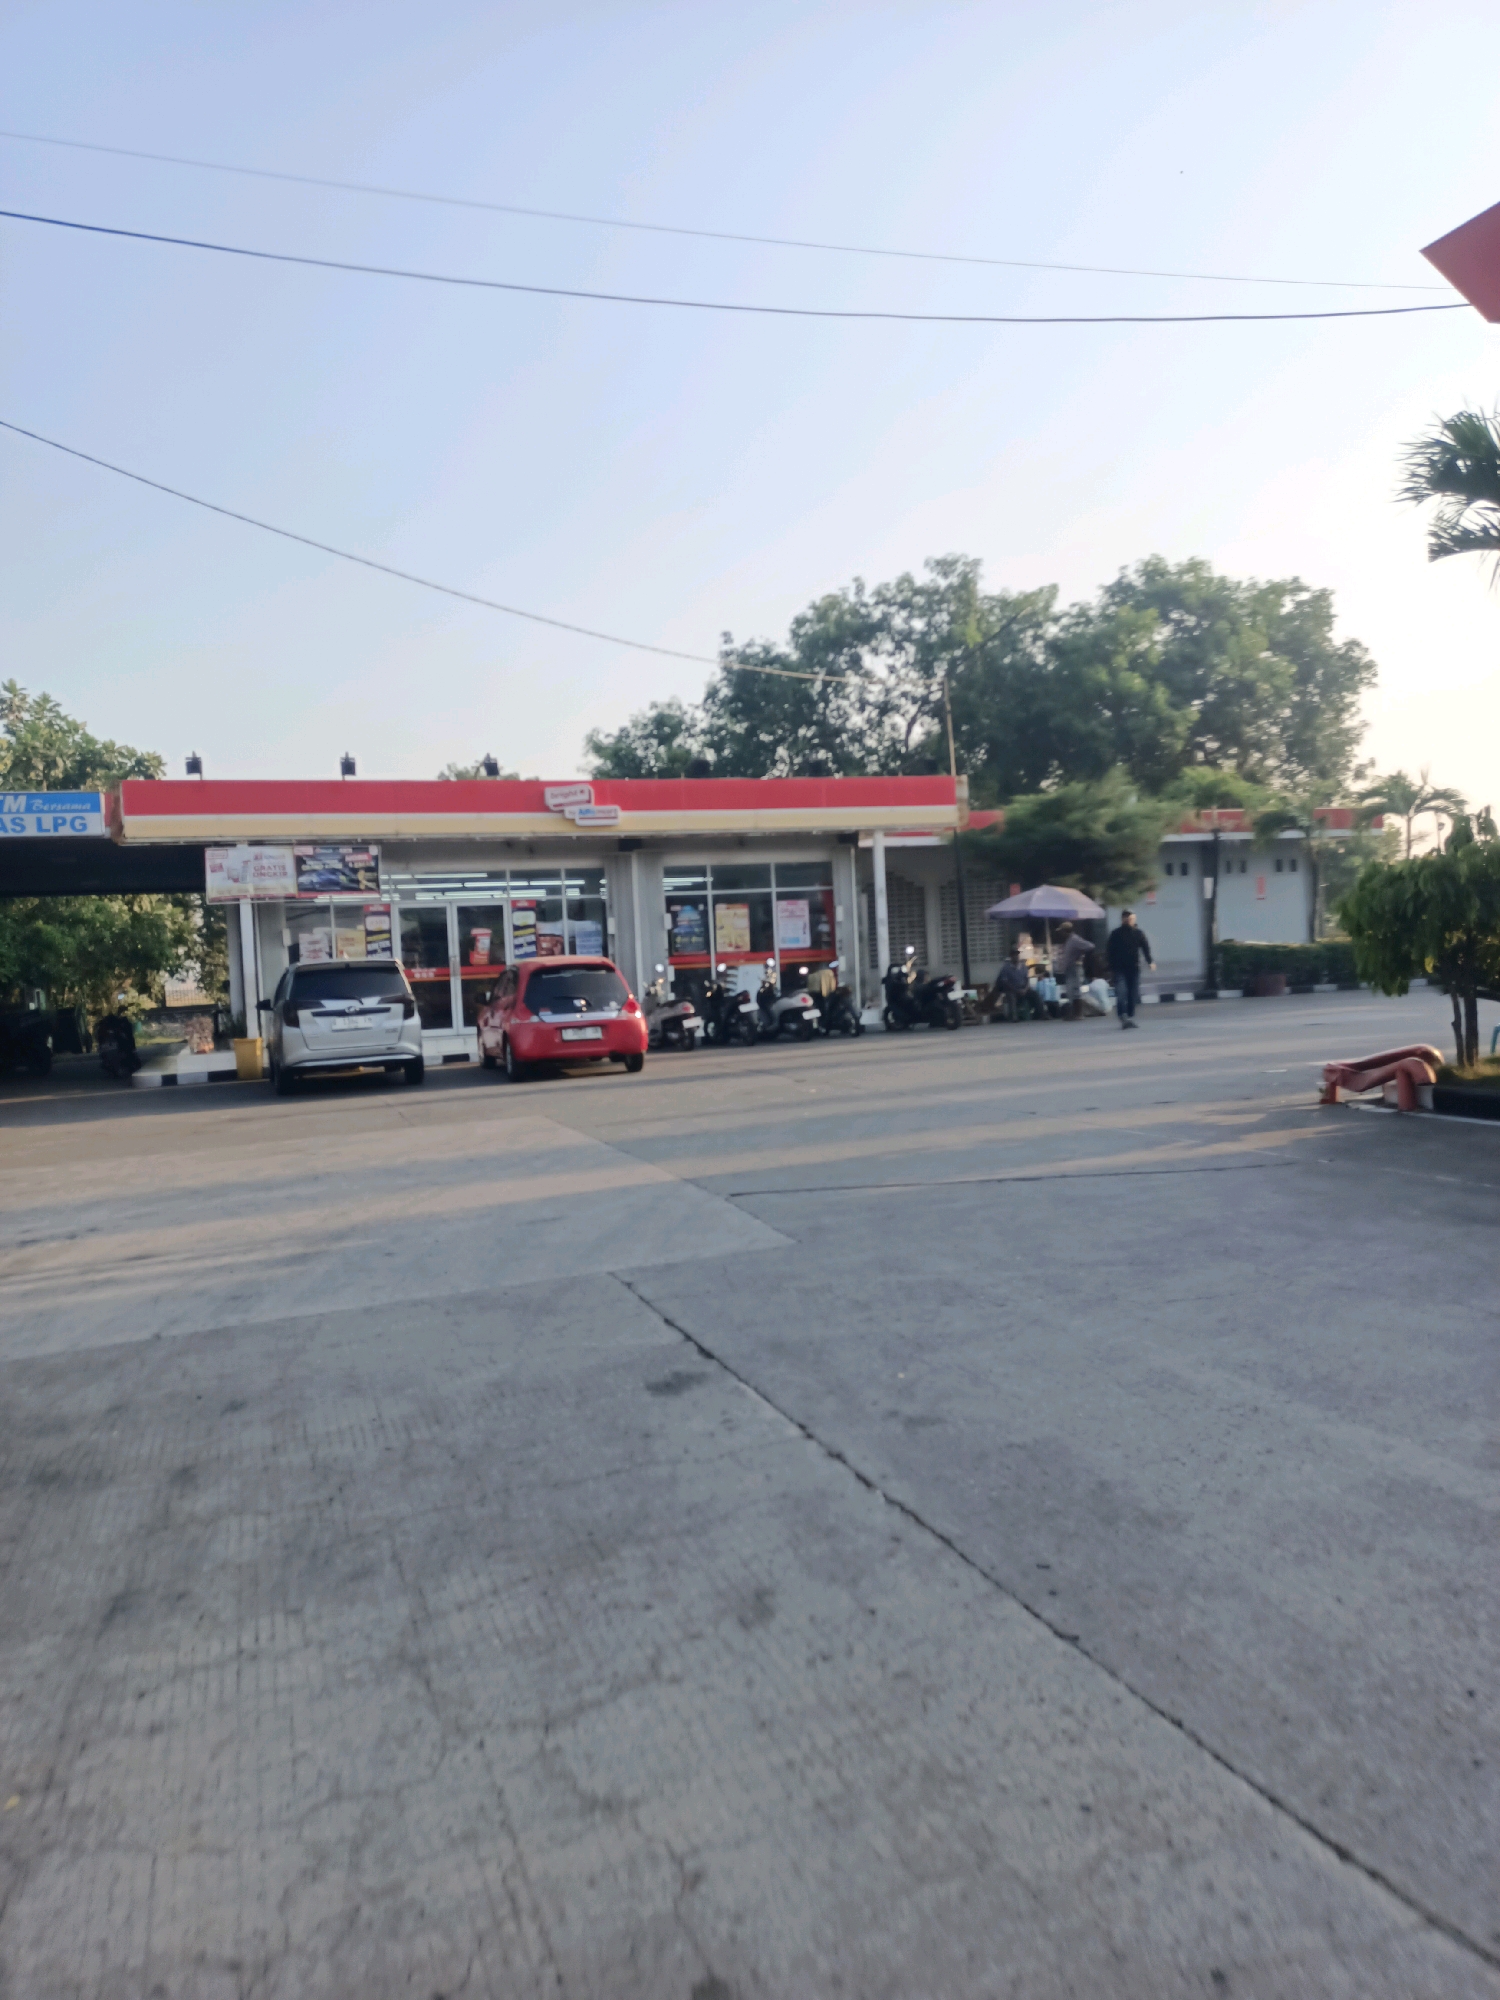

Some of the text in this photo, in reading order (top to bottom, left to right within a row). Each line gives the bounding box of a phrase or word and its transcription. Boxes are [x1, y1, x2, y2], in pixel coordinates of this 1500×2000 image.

[0, 795, 92, 813] M Bersama
[35, 815, 88, 833] LPG
[253, 864, 287, 872] GRATIS
